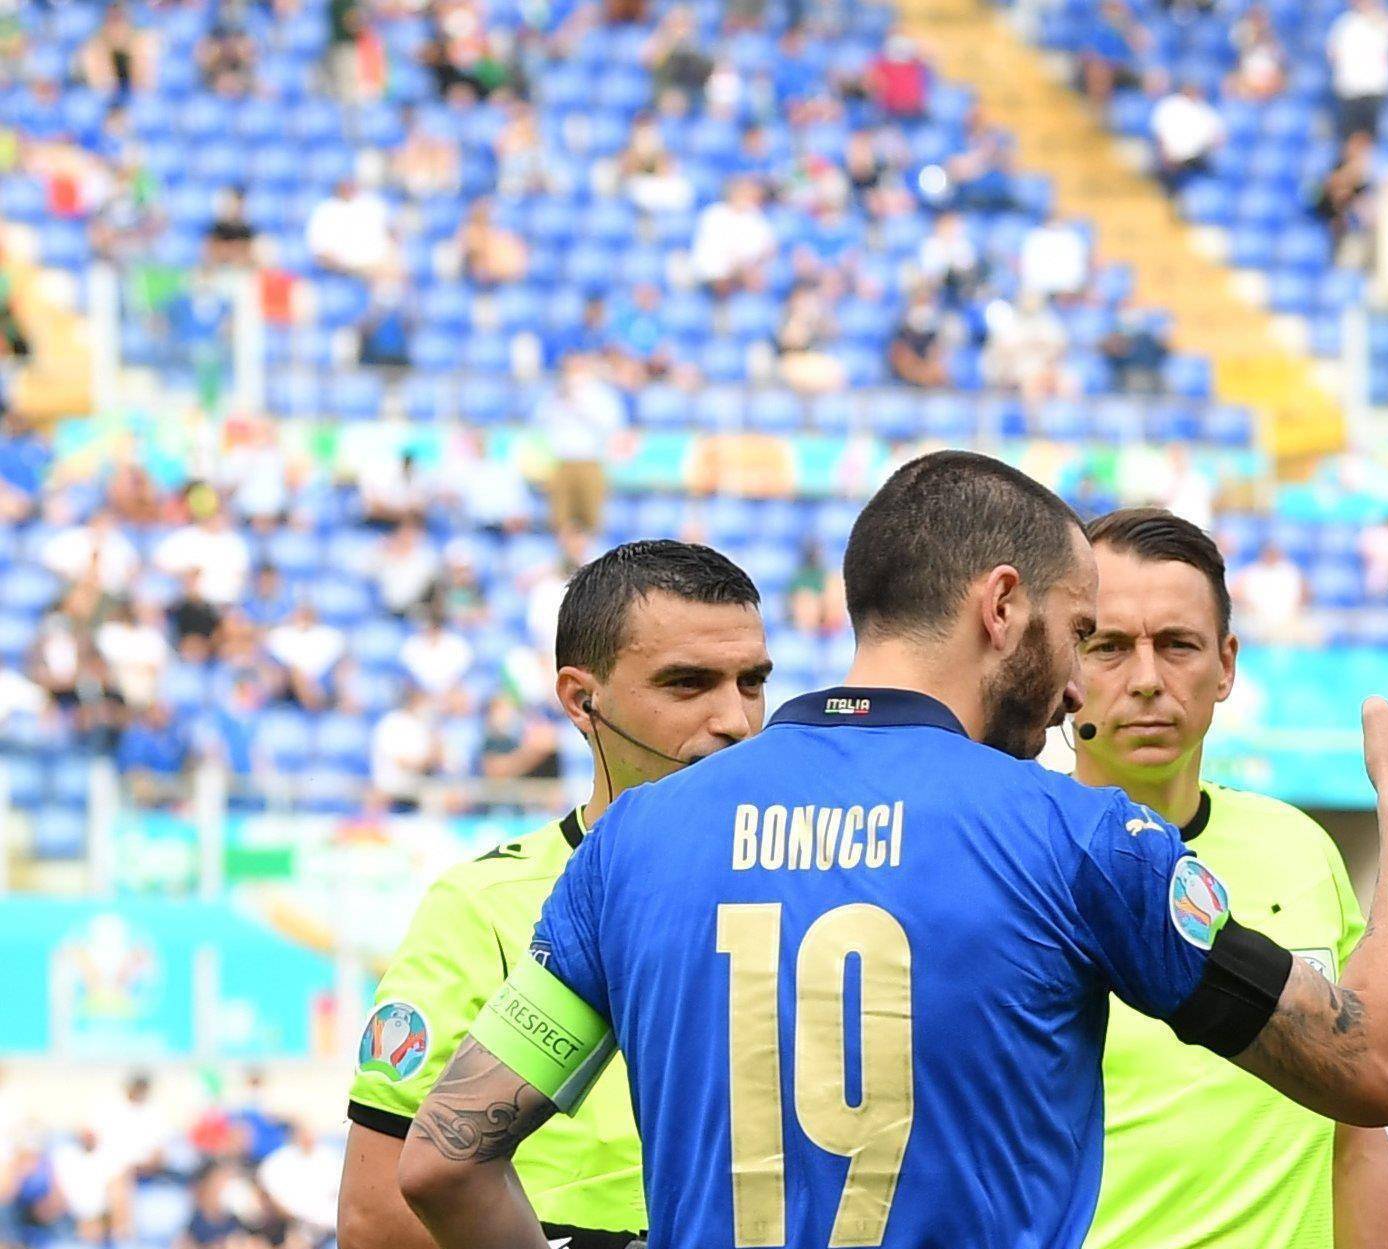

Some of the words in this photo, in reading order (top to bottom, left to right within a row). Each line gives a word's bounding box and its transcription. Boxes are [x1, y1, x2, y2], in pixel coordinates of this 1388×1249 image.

[826, 698, 870, 711] ITALIA
[732, 801, 903, 871] BONUCCI
[505, 999, 579, 1060] RESPECT
[716, 902, 914, 1249] 19
